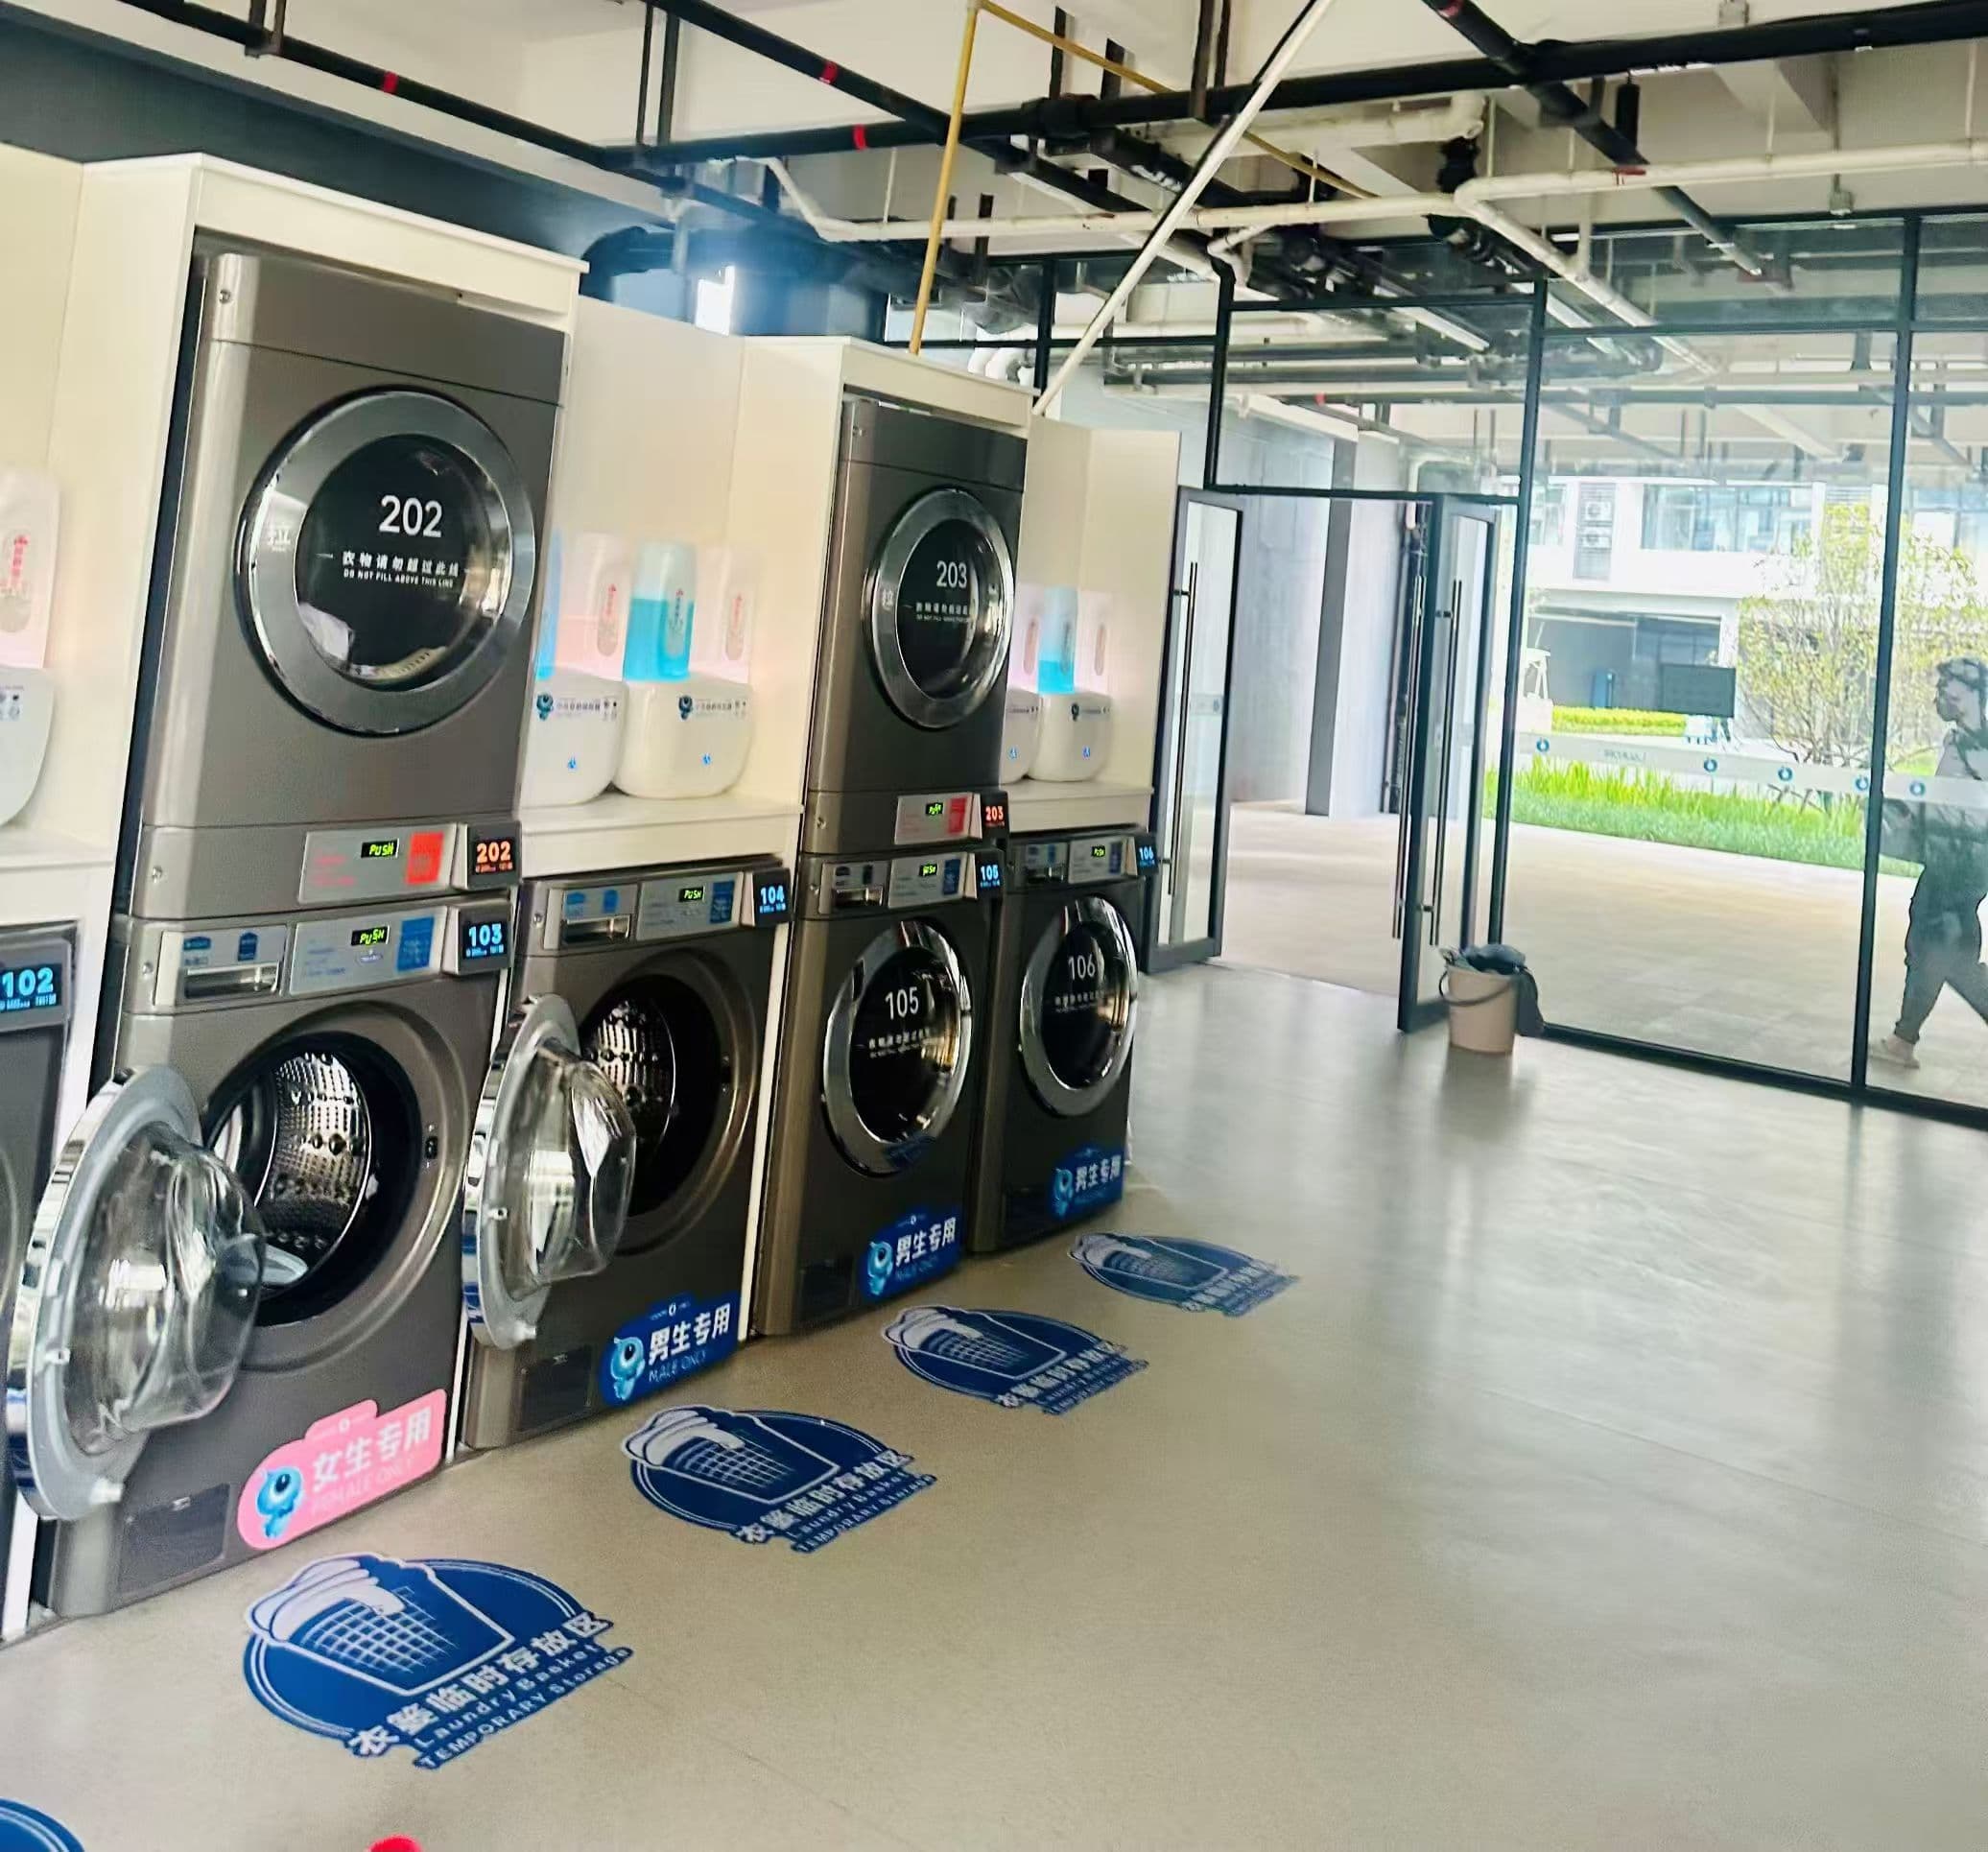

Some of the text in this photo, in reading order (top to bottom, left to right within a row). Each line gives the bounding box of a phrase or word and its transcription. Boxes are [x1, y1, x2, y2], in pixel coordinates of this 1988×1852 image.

[379, 494, 442, 537] 202
[343, 568, 355, 579] DO
[357, 570, 373, 581] NOT
[394, 574, 419, 585] ABOVE
[936, 560, 968, 588] 203
[985, 806, 1004, 821] 203
[476, 841, 511, 864] 202
[1139, 846, 1154, 861] 106
[760, 885, 785, 905] 104
[469, 923, 503, 947] 103
[1068, 954, 1096, 980] 106
[2, 967, 54, 998] 102
[885, 986, 919, 1020] 105
[896, 1217, 957, 1268] 男生专用
[649, 1302, 731, 1366] 男生专用
[312, 1407, 432, 1493] 女生专用
[414, 1643, 600, 1748] Laundry Basket
[421, 1648, 632, 1768] TEMPORARY Storage
